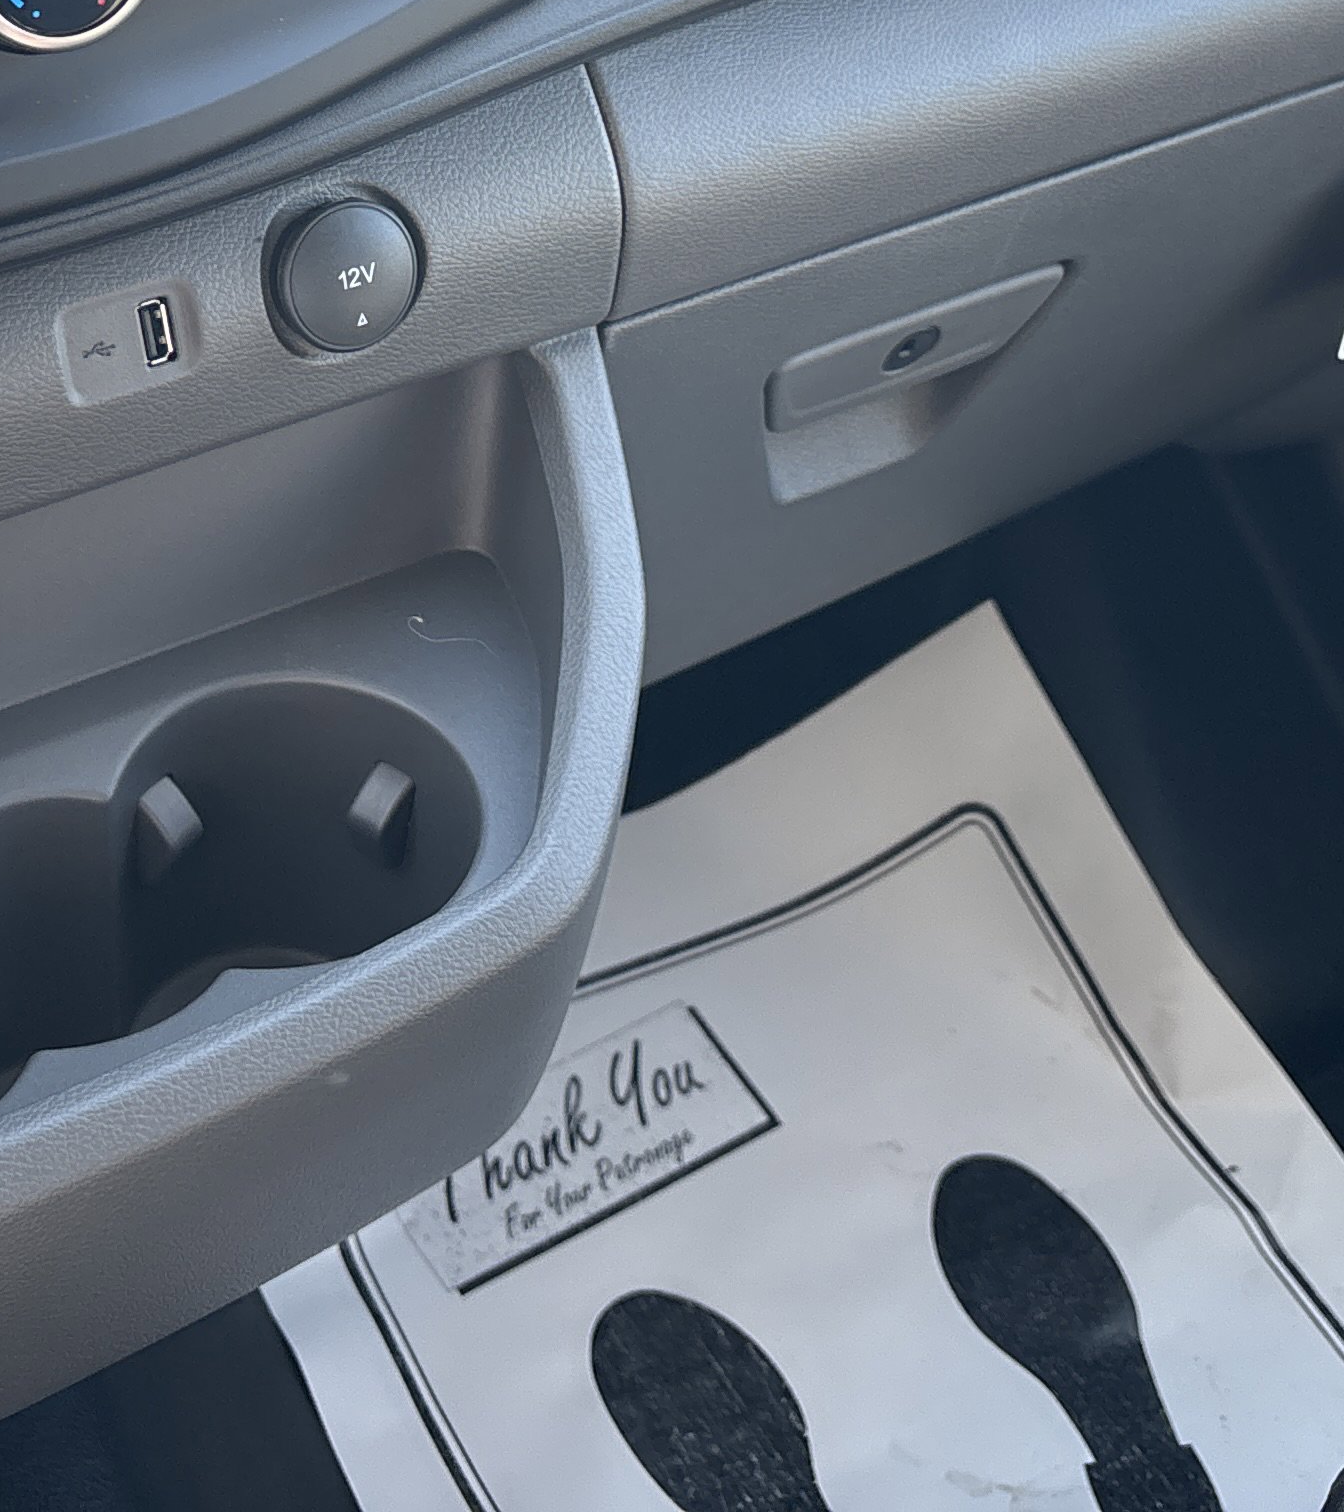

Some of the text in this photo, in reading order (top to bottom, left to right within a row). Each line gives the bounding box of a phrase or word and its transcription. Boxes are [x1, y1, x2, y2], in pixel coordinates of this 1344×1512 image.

[338, 261, 376, 291] 12V
[609, 1039, 706, 1126] You
[504, 1127, 696, 1240] For Your Patronage
